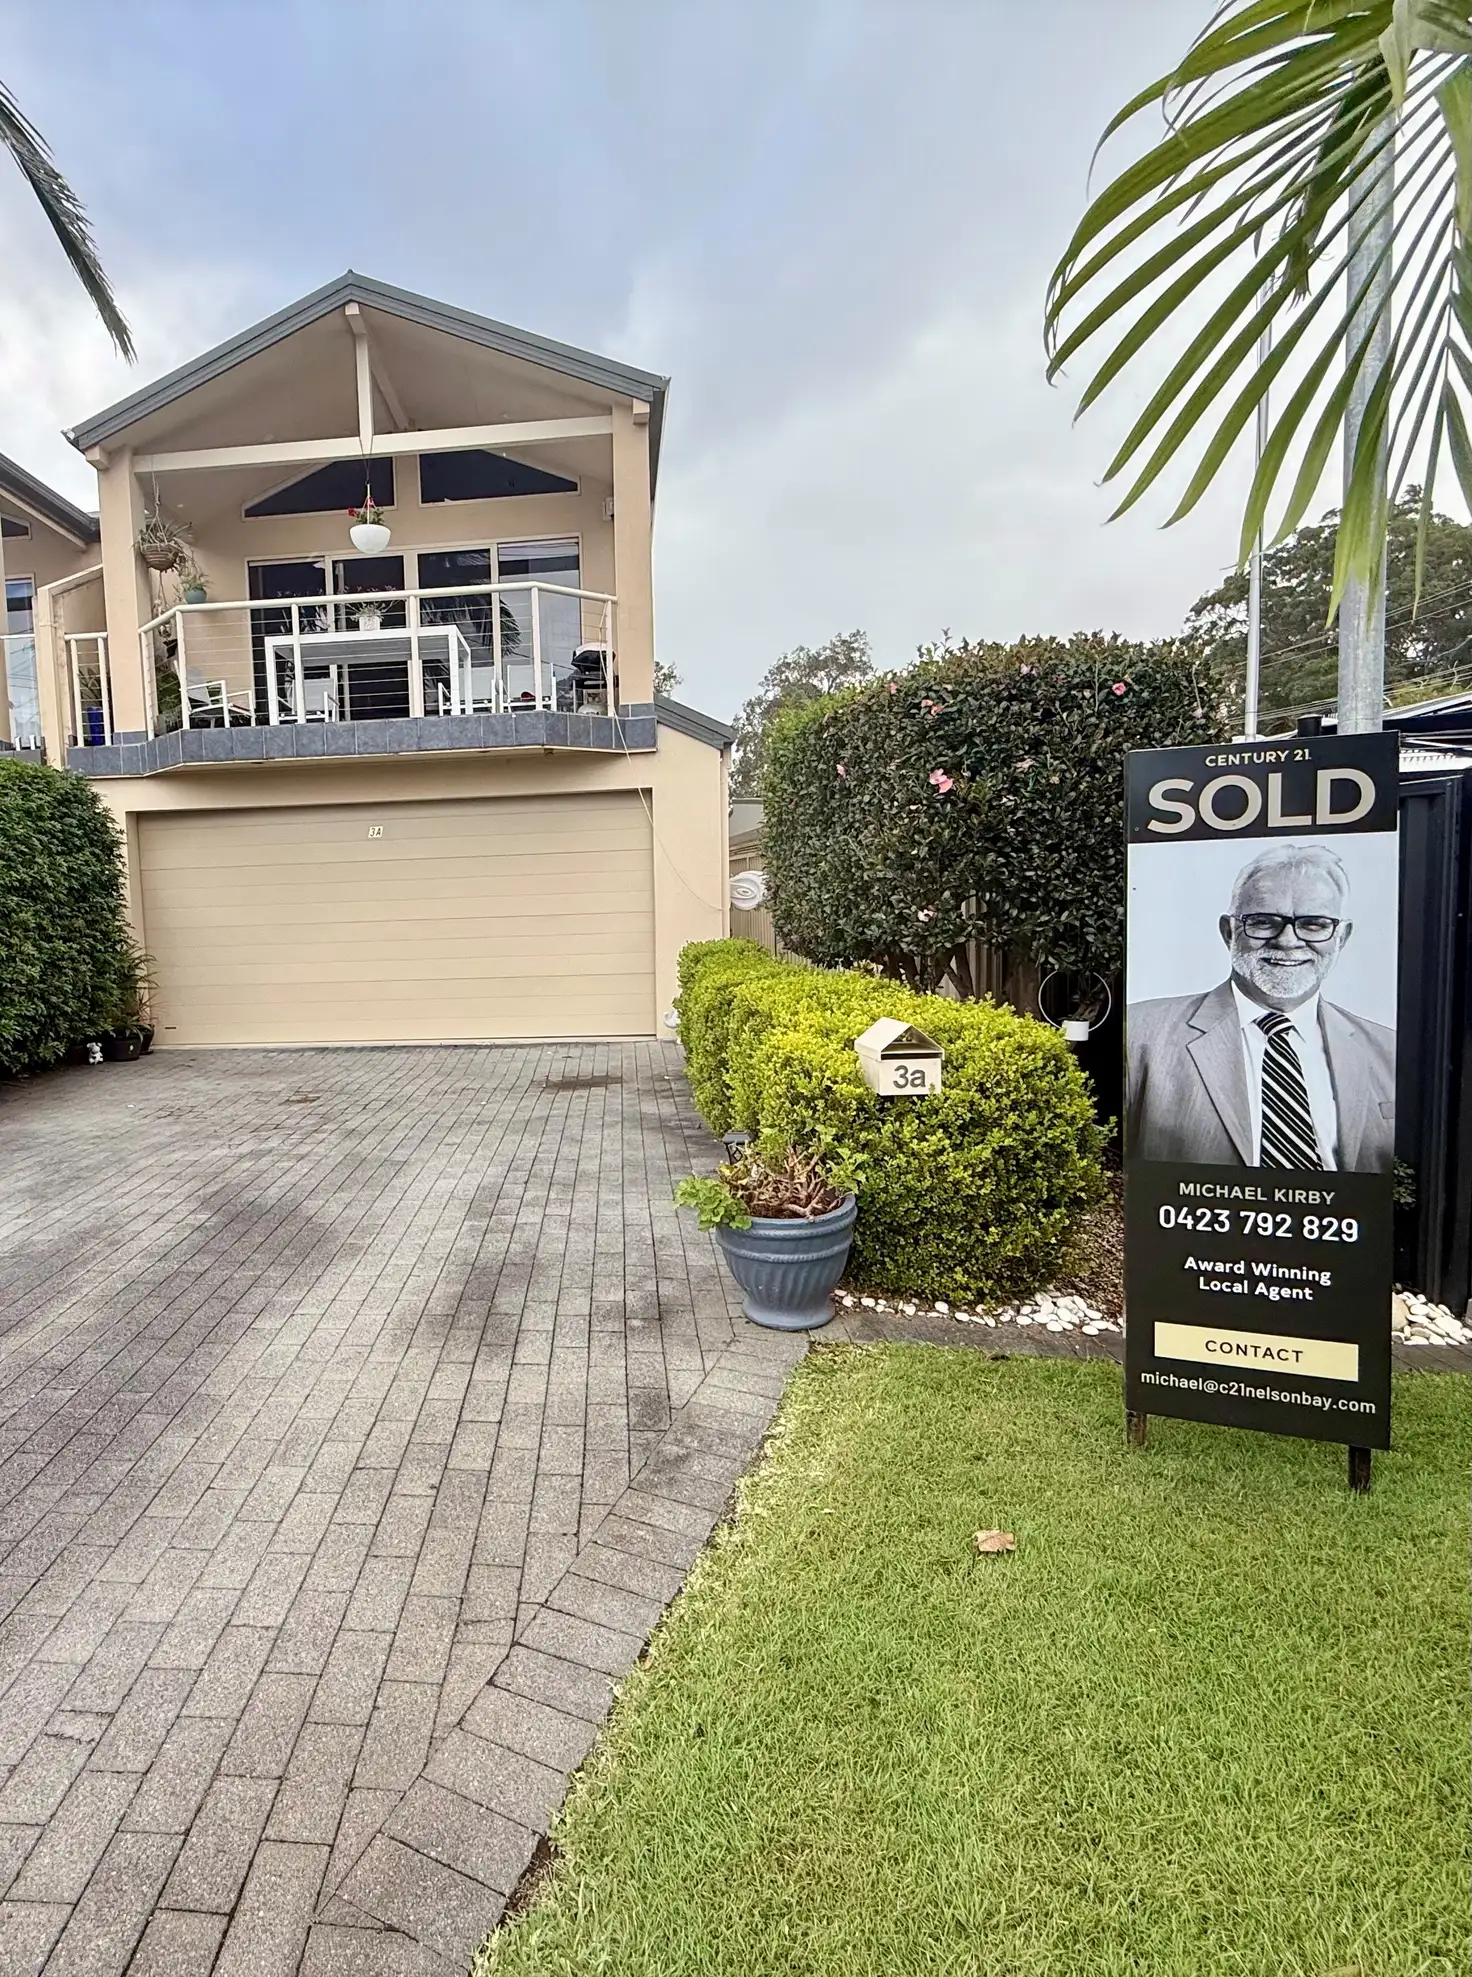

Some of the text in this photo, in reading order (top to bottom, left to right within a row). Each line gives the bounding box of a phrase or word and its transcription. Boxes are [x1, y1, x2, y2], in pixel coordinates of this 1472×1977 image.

[1205, 750, 1289, 767] CENTURY
[1147, 768, 1376, 834] SOLD
[370, 827, 381, 836] 3A
[892, 1064, 926, 1089] 3a
[1179, 1182, 1336, 1205] MICHAEL KIRBY
[1158, 1205, 1359, 1243] 0423 792 829
[1184, 1256, 1332, 1286] Award Winning
[1199, 1276, 1313, 1301] Local Agent
[1205, 1339, 1303, 1363] CONTACT
[1141, 1371, 1376, 1414] michael@c21nelsonbay.com
